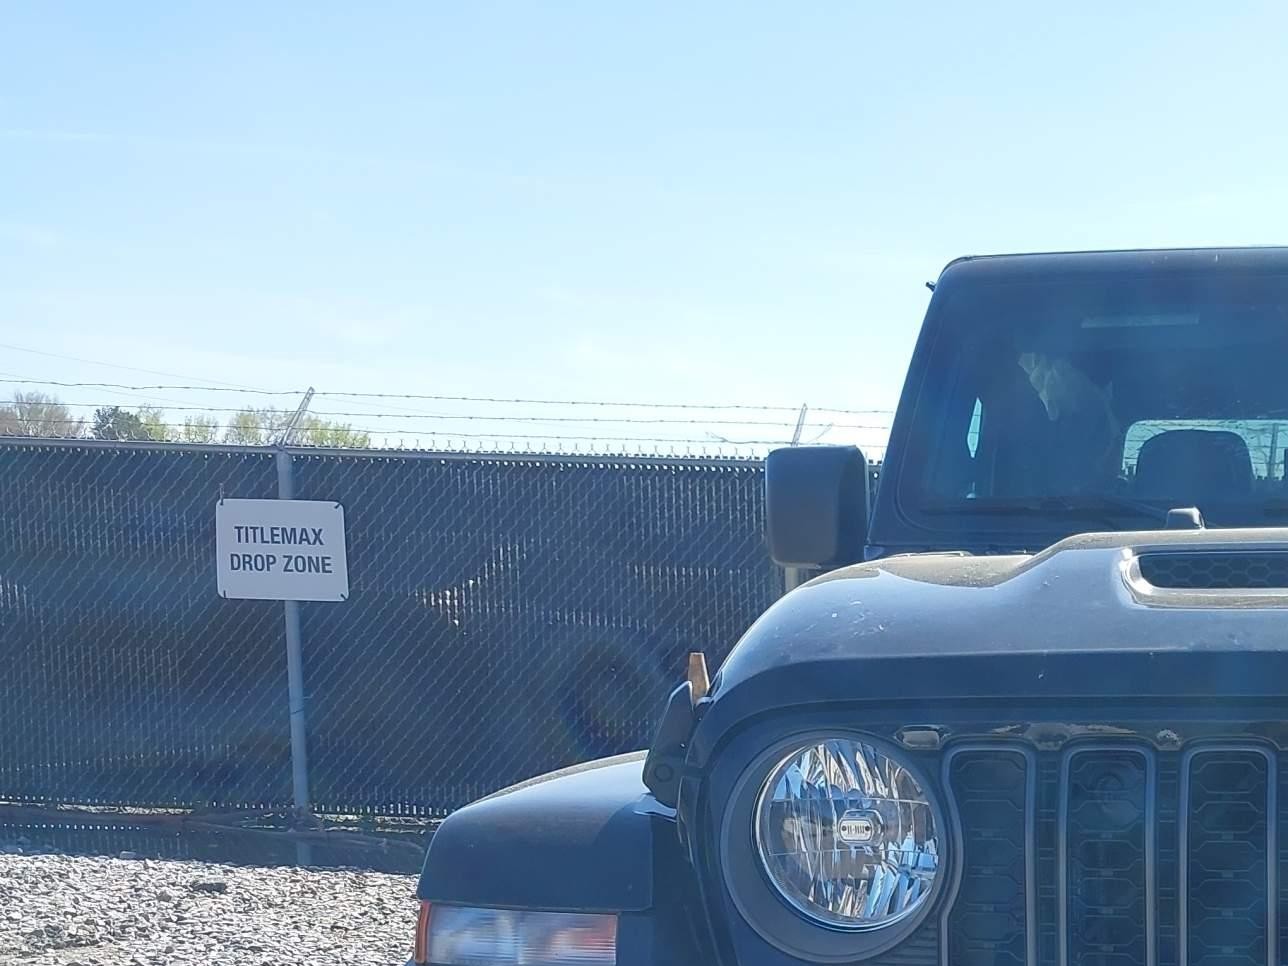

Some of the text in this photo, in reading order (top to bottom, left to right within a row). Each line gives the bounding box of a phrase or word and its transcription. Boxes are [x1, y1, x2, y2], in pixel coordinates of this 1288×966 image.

[234, 526, 324, 546] TITLEMAX
[230, 553, 333, 574] DROP ZONE
